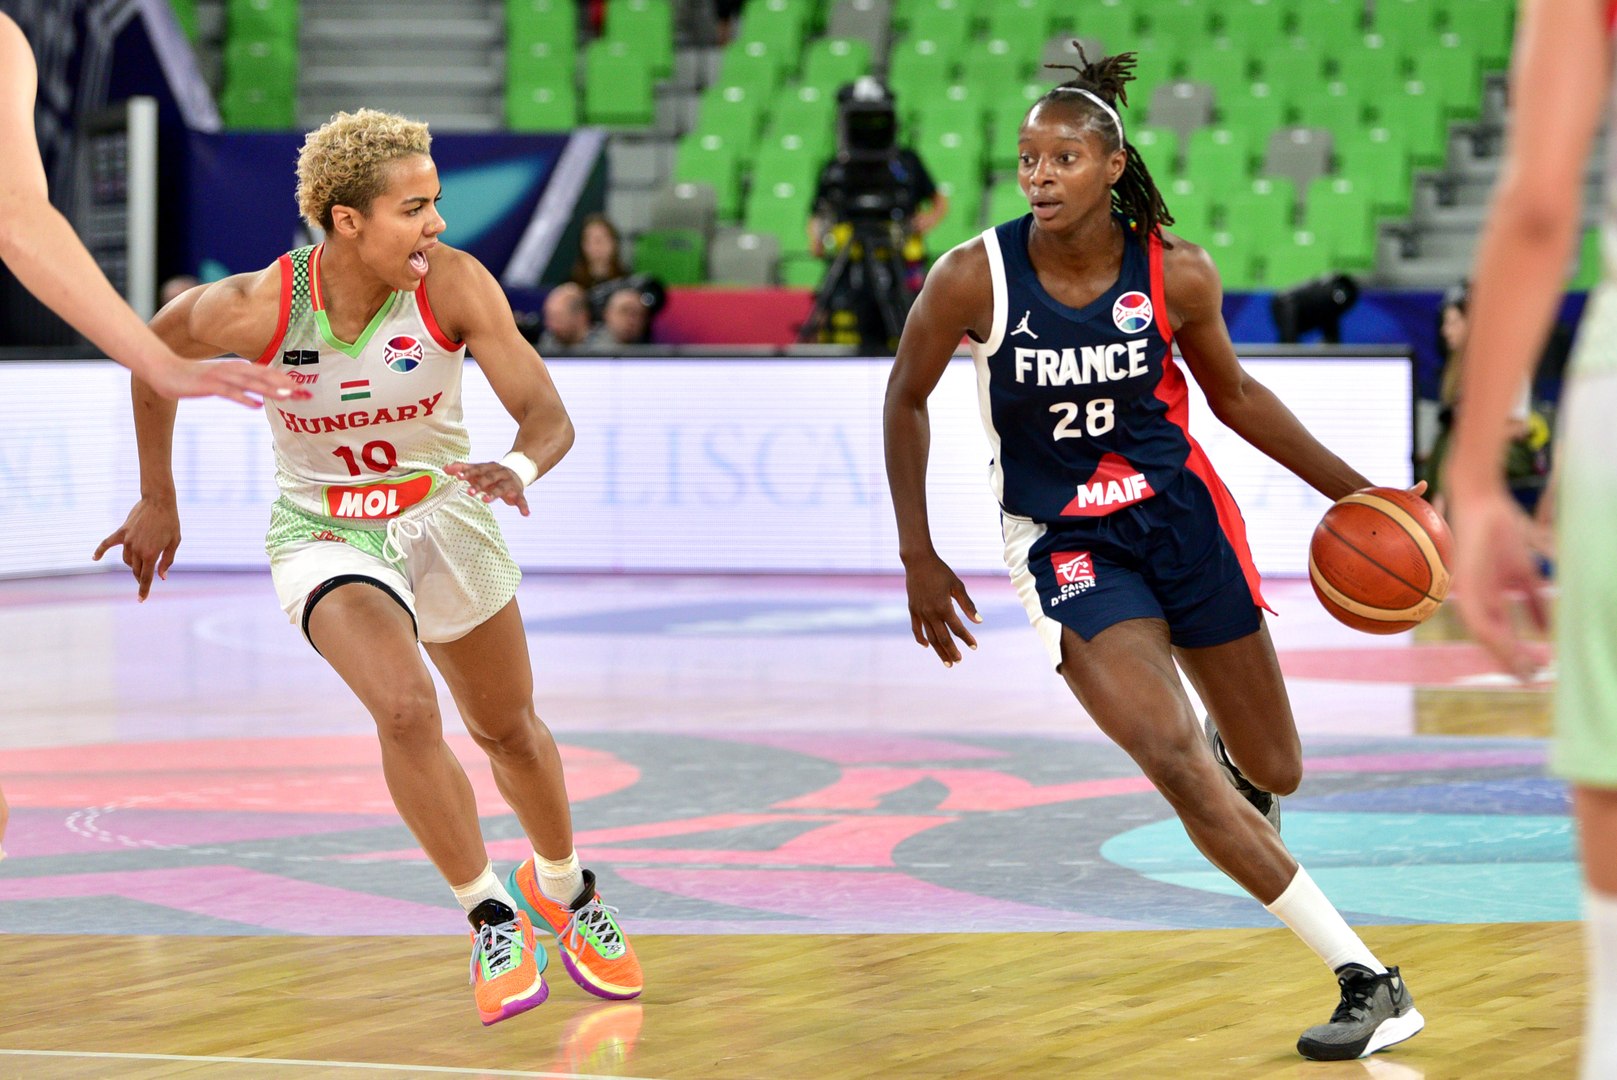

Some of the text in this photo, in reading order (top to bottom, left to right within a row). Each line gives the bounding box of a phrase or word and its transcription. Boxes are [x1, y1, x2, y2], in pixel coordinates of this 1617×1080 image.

[1014, 338, 1149, 387] FRANCE
[277, 391, 443, 434] HUNGARY
[1049, 398, 1115, 442] 28
[332, 440, 398, 477] 10
[599, 421, 883, 509] LISCA
[336, 489, 400, 517] MOL
[1077, 473, 1147, 508] MAIF
